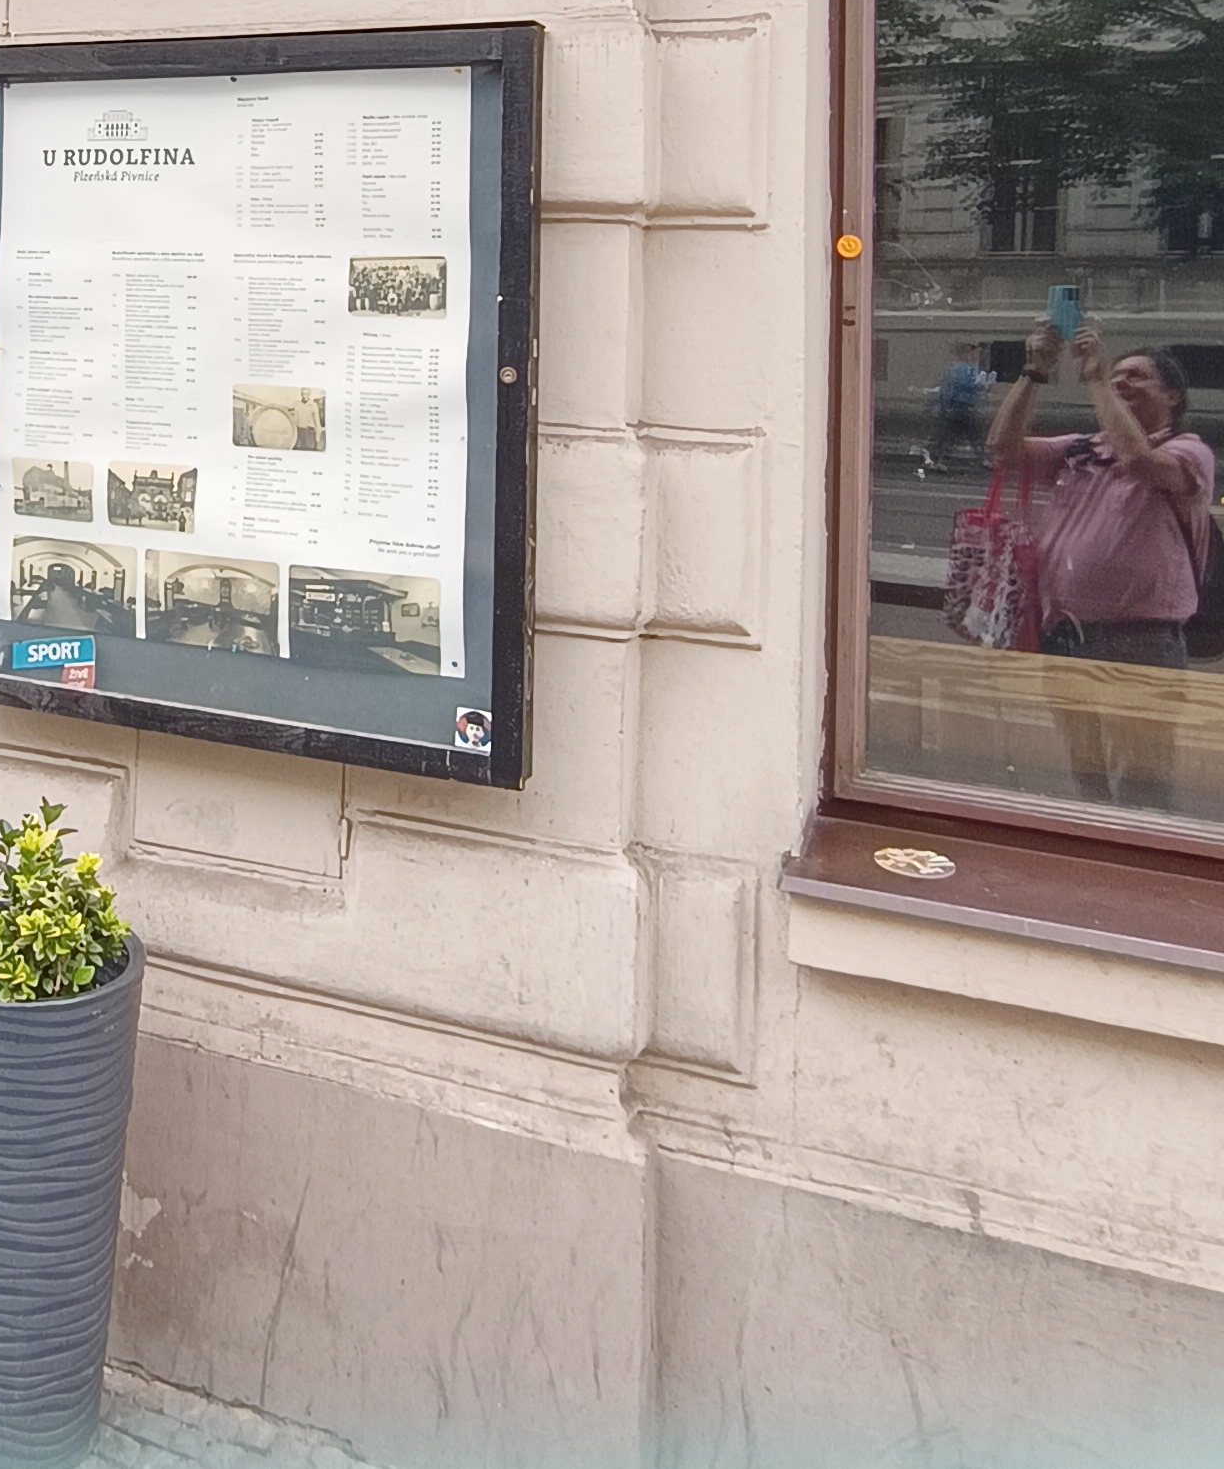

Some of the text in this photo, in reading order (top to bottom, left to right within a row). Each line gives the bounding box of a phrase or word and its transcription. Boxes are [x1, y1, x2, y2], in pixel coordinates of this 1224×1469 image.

[43, 148, 195, 166] U RUDOLFINA
[27, 641, 81, 663] SPORT
